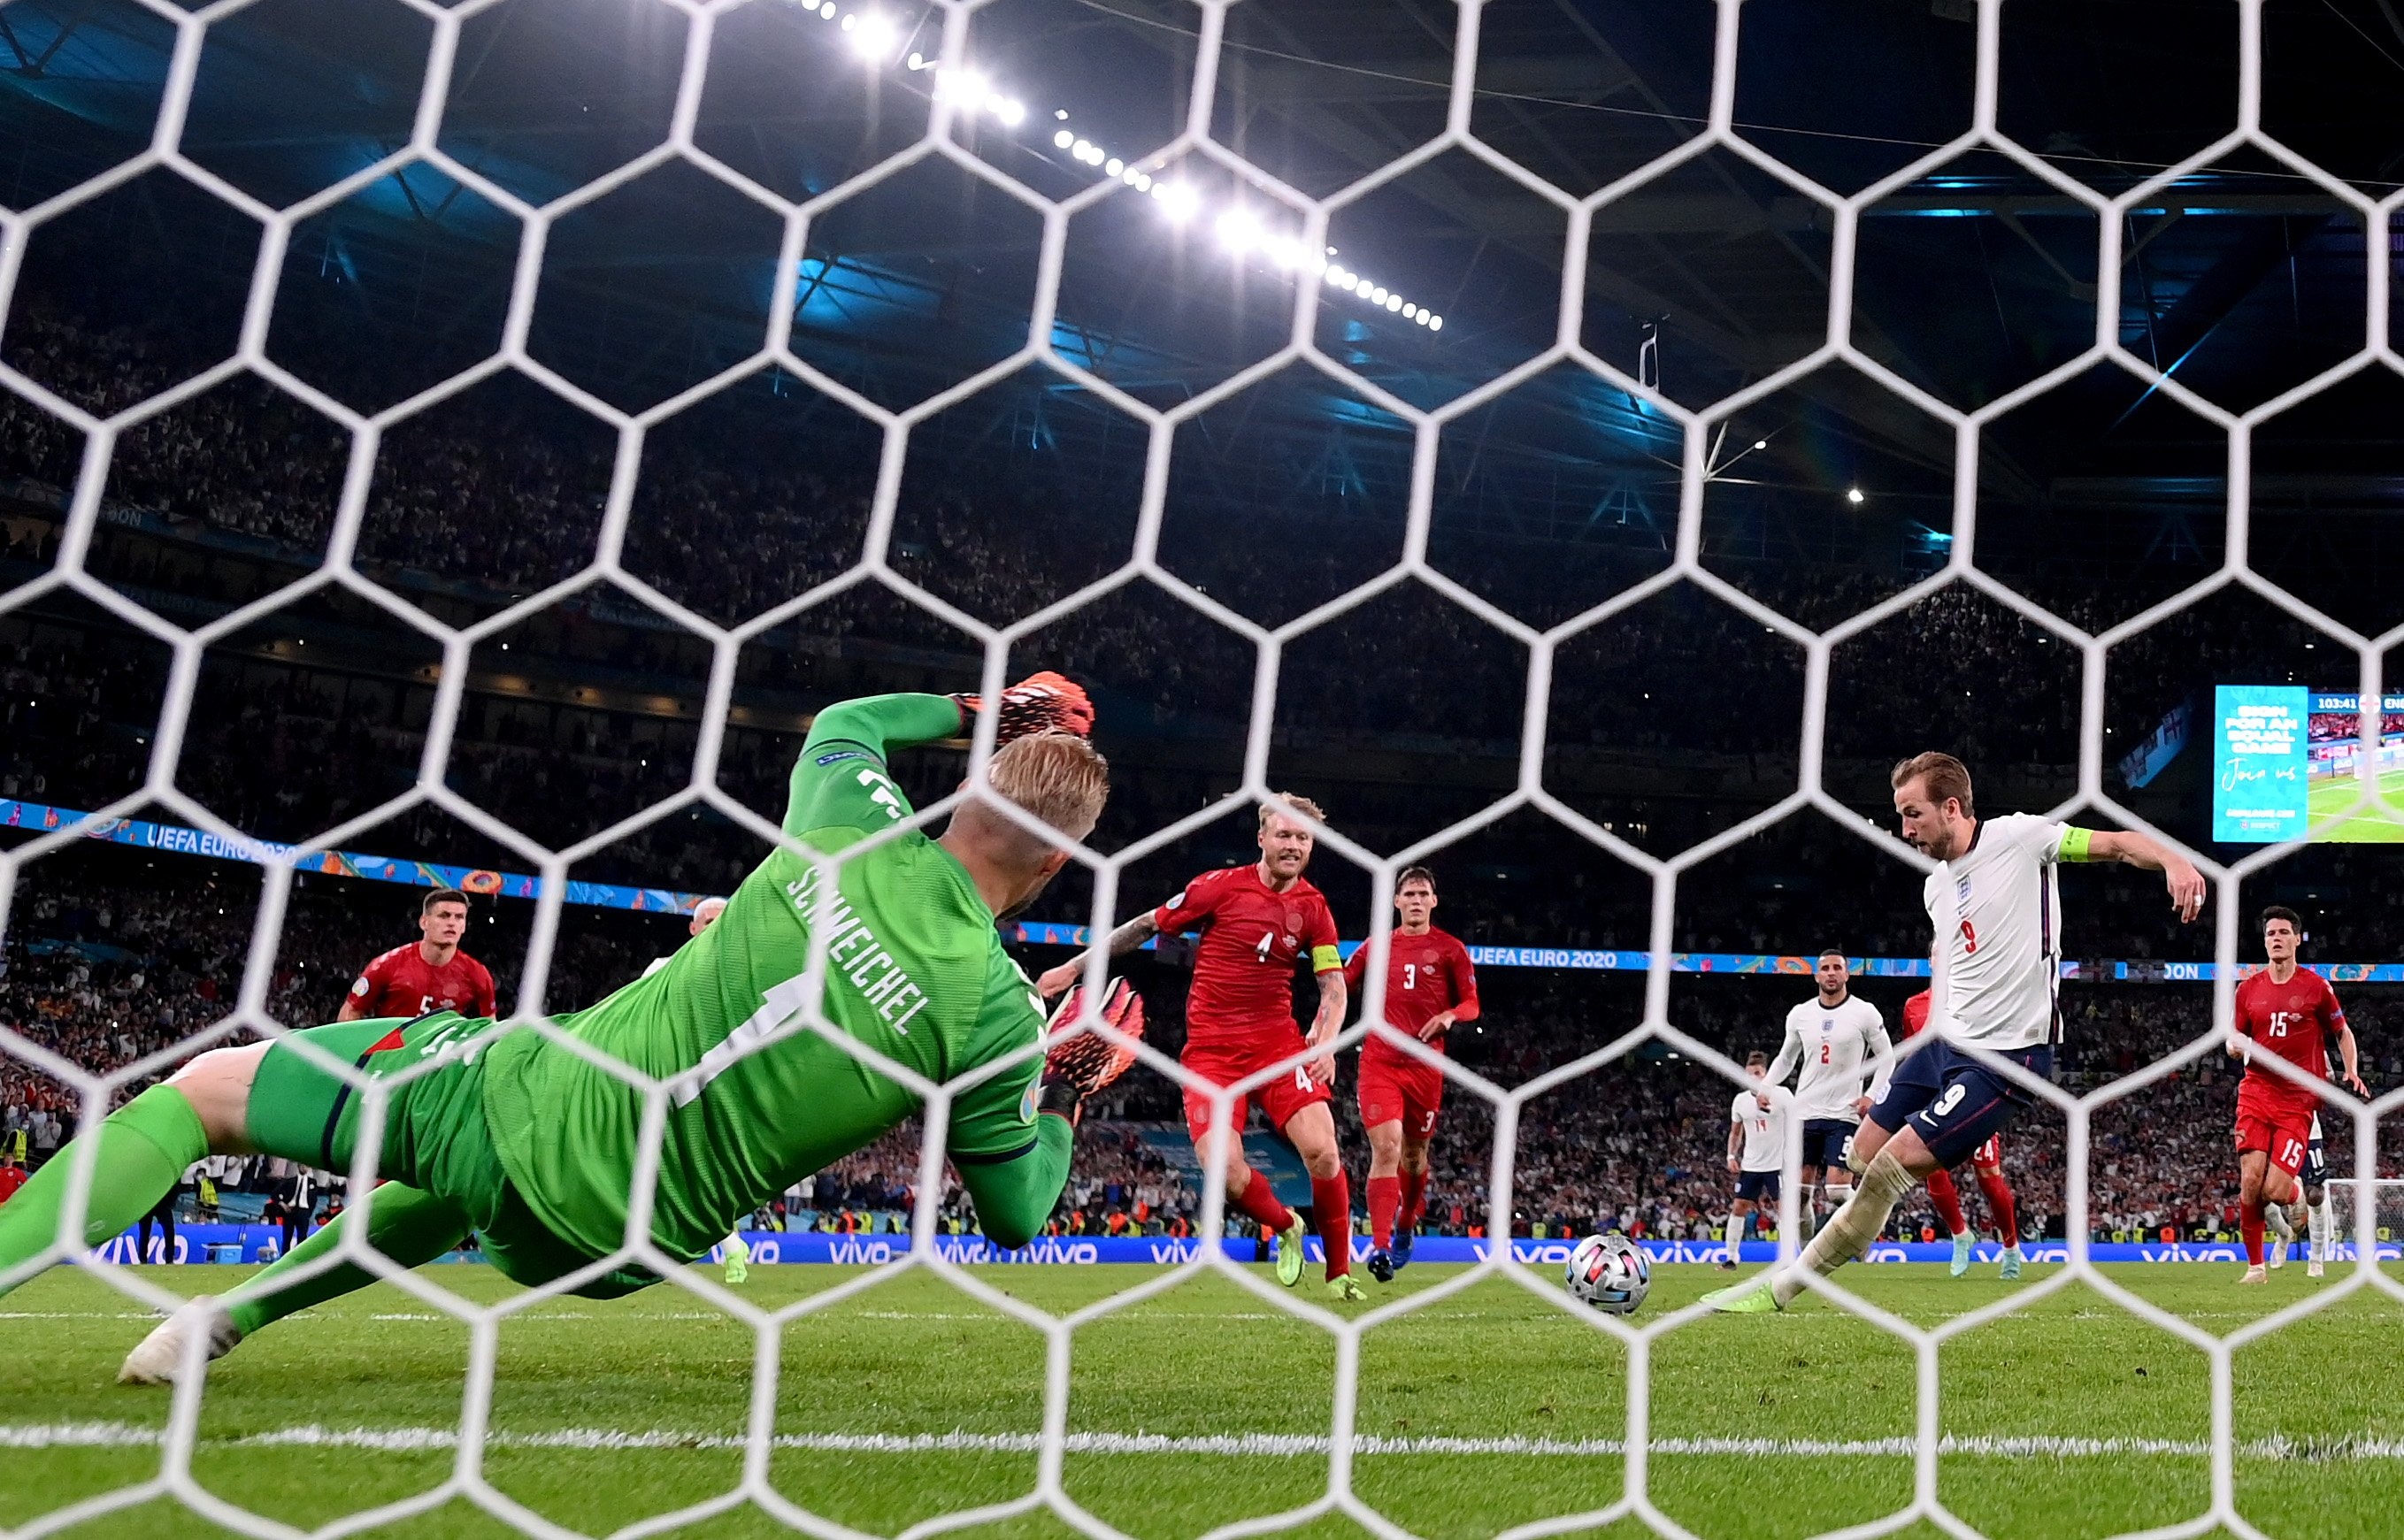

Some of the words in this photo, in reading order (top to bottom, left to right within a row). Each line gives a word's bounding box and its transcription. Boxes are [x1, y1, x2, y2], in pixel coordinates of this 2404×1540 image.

[2318, 698, 2356, 709] 103:41
[2221, 757, 2266, 792] Join
[2275, 767, 2296, 780] us
[147, 824, 198, 853] UEFA
[1256, 931, 1274, 962] 4
[1961, 920, 1976, 954] 9
[1469, 947, 1517, 964] UEFA
[1520, 949, 1570, 967] EURO
[1571, 951, 1617, 969] 2020
[1403, 963, 1416, 990] 3
[416, 995, 434, 1017] 5
[2269, 1011, 2288, 1038] 15
[1821, 1044, 1830, 1065] 2
[1295, 1064, 1314, 1093] 4
[1934, 1084, 1966, 1116] 9
[1420, 1110, 1435, 1132] 3
[2280, 1138, 2304, 1168] 15
[2308, 1147, 2324, 1168] 10
[829, 1234, 891, 1264] vivo
[1030, 1237, 1098, 1264] vivo
[1151, 1238, 1201, 1263] viv
[1643, 1241, 1740, 1263] vivo
[2140, 1243, 2238, 1262] vivo
